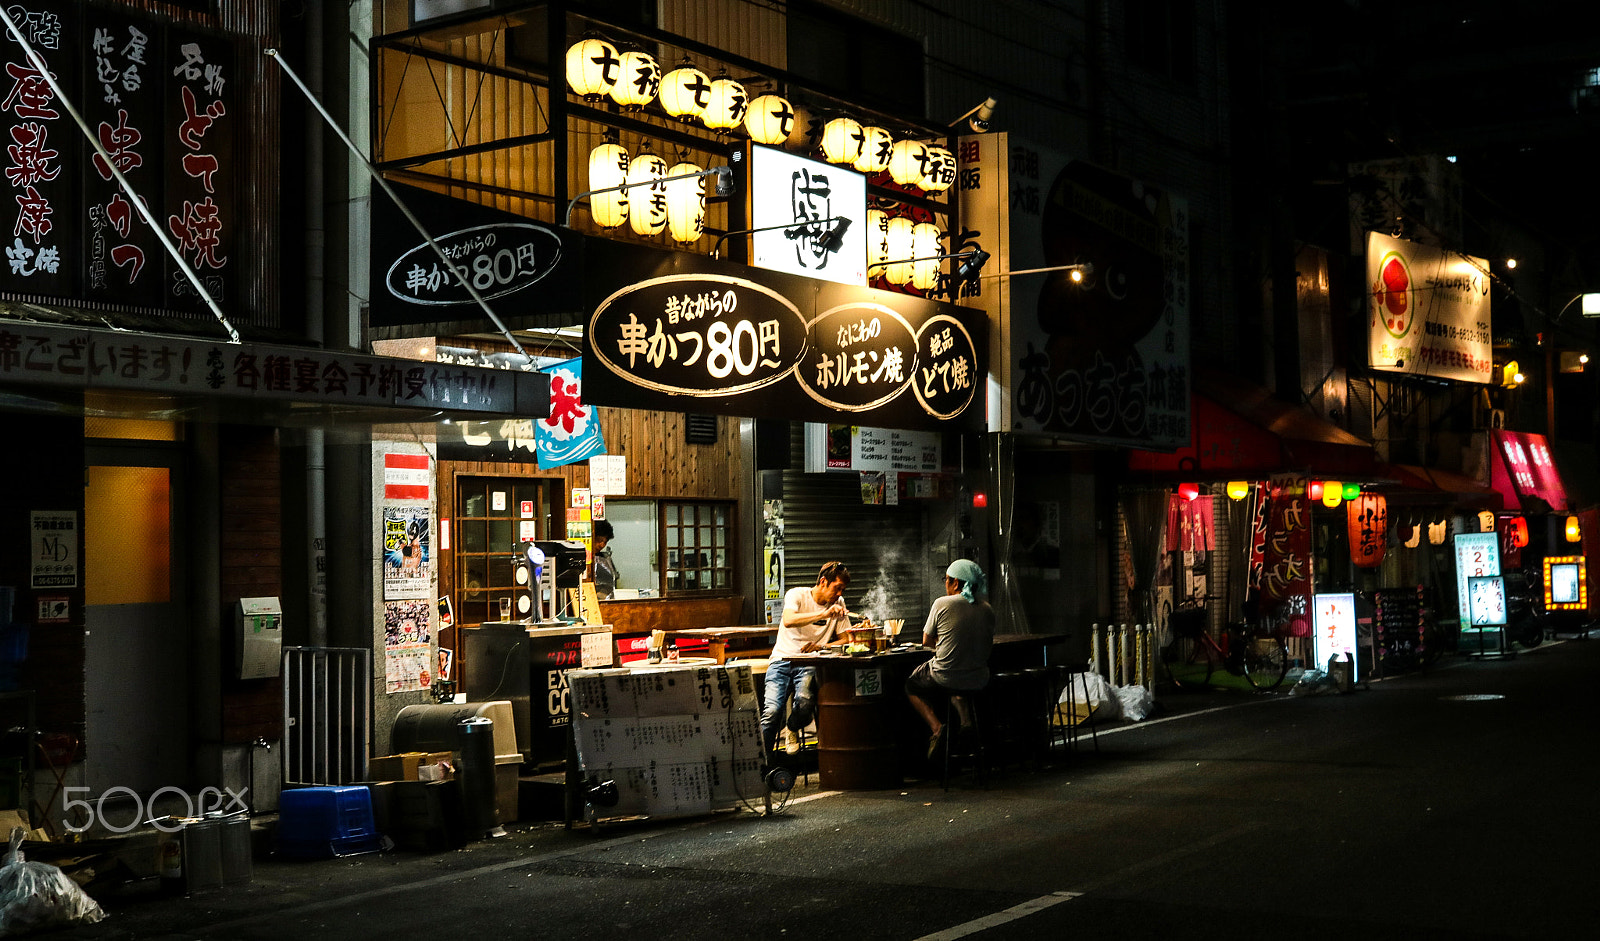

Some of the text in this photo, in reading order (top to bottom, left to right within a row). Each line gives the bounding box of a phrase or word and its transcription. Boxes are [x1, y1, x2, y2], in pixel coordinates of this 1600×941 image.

[4, 6, 61, 50] 2階
[174, 42, 226, 97] 名物
[2, 50, 62, 244] 座敷席
[929, 151, 957, 184] 福
[92, 109, 149, 285] 串かつ
[169, 85, 228, 271] どて焼
[650, 160, 668, 228] ホルモン
[6, 238, 60, 277] 完備
[664, 290, 738, 324] 昔ながらの
[837, 318, 881, 348] なにわの
[929, 327, 954, 359] 絶品
[815, 346, 904, 391] ホルモン焼
[921, 358, 970, 399] どて焼
[41, 536, 69, 562] MD
[697, 668, 713, 710] 串カツ
[856, 670, 879, 694] 福
